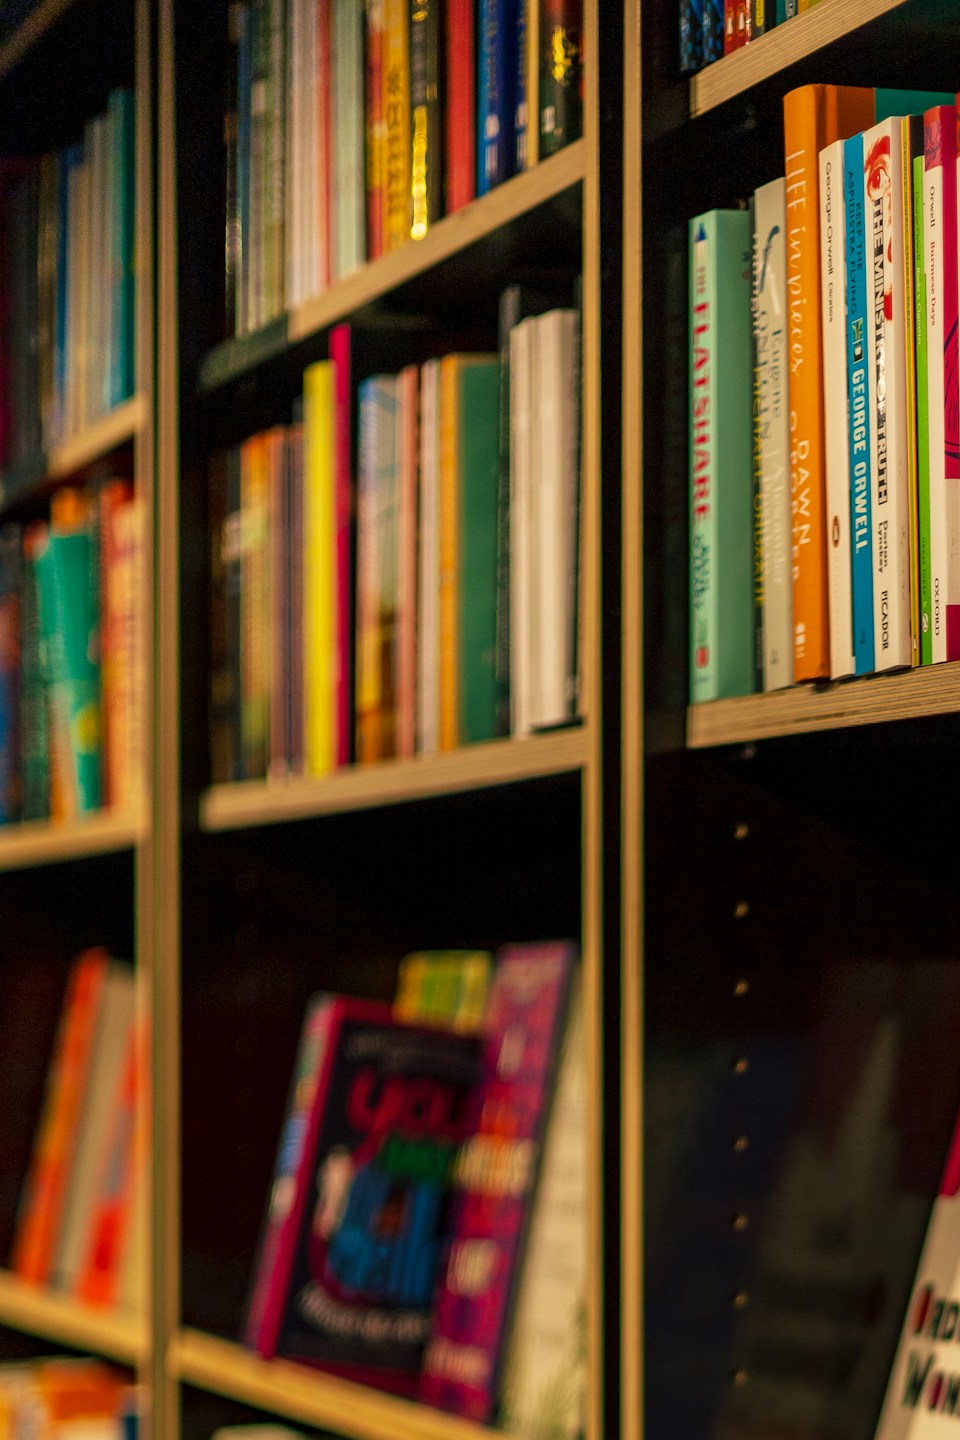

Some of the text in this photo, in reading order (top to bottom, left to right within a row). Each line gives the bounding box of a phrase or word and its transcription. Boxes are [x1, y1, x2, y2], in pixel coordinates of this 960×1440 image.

[786, 149, 807, 378] LIFE in pieces
[825, 161, 835, 323] George Orwell Diaries
[847, 171, 858, 316] ASPIDISTRA FLYING
[856, 201, 864, 271] KEEP THE
[930, 297, 938, 327] Days
[692, 302, 710, 526] FLATSHARE
[852, 368, 869, 554] GEORGE ORWELL
[798, 439, 812, 546] DAWN
[880, 590, 890, 651] PICADOR
